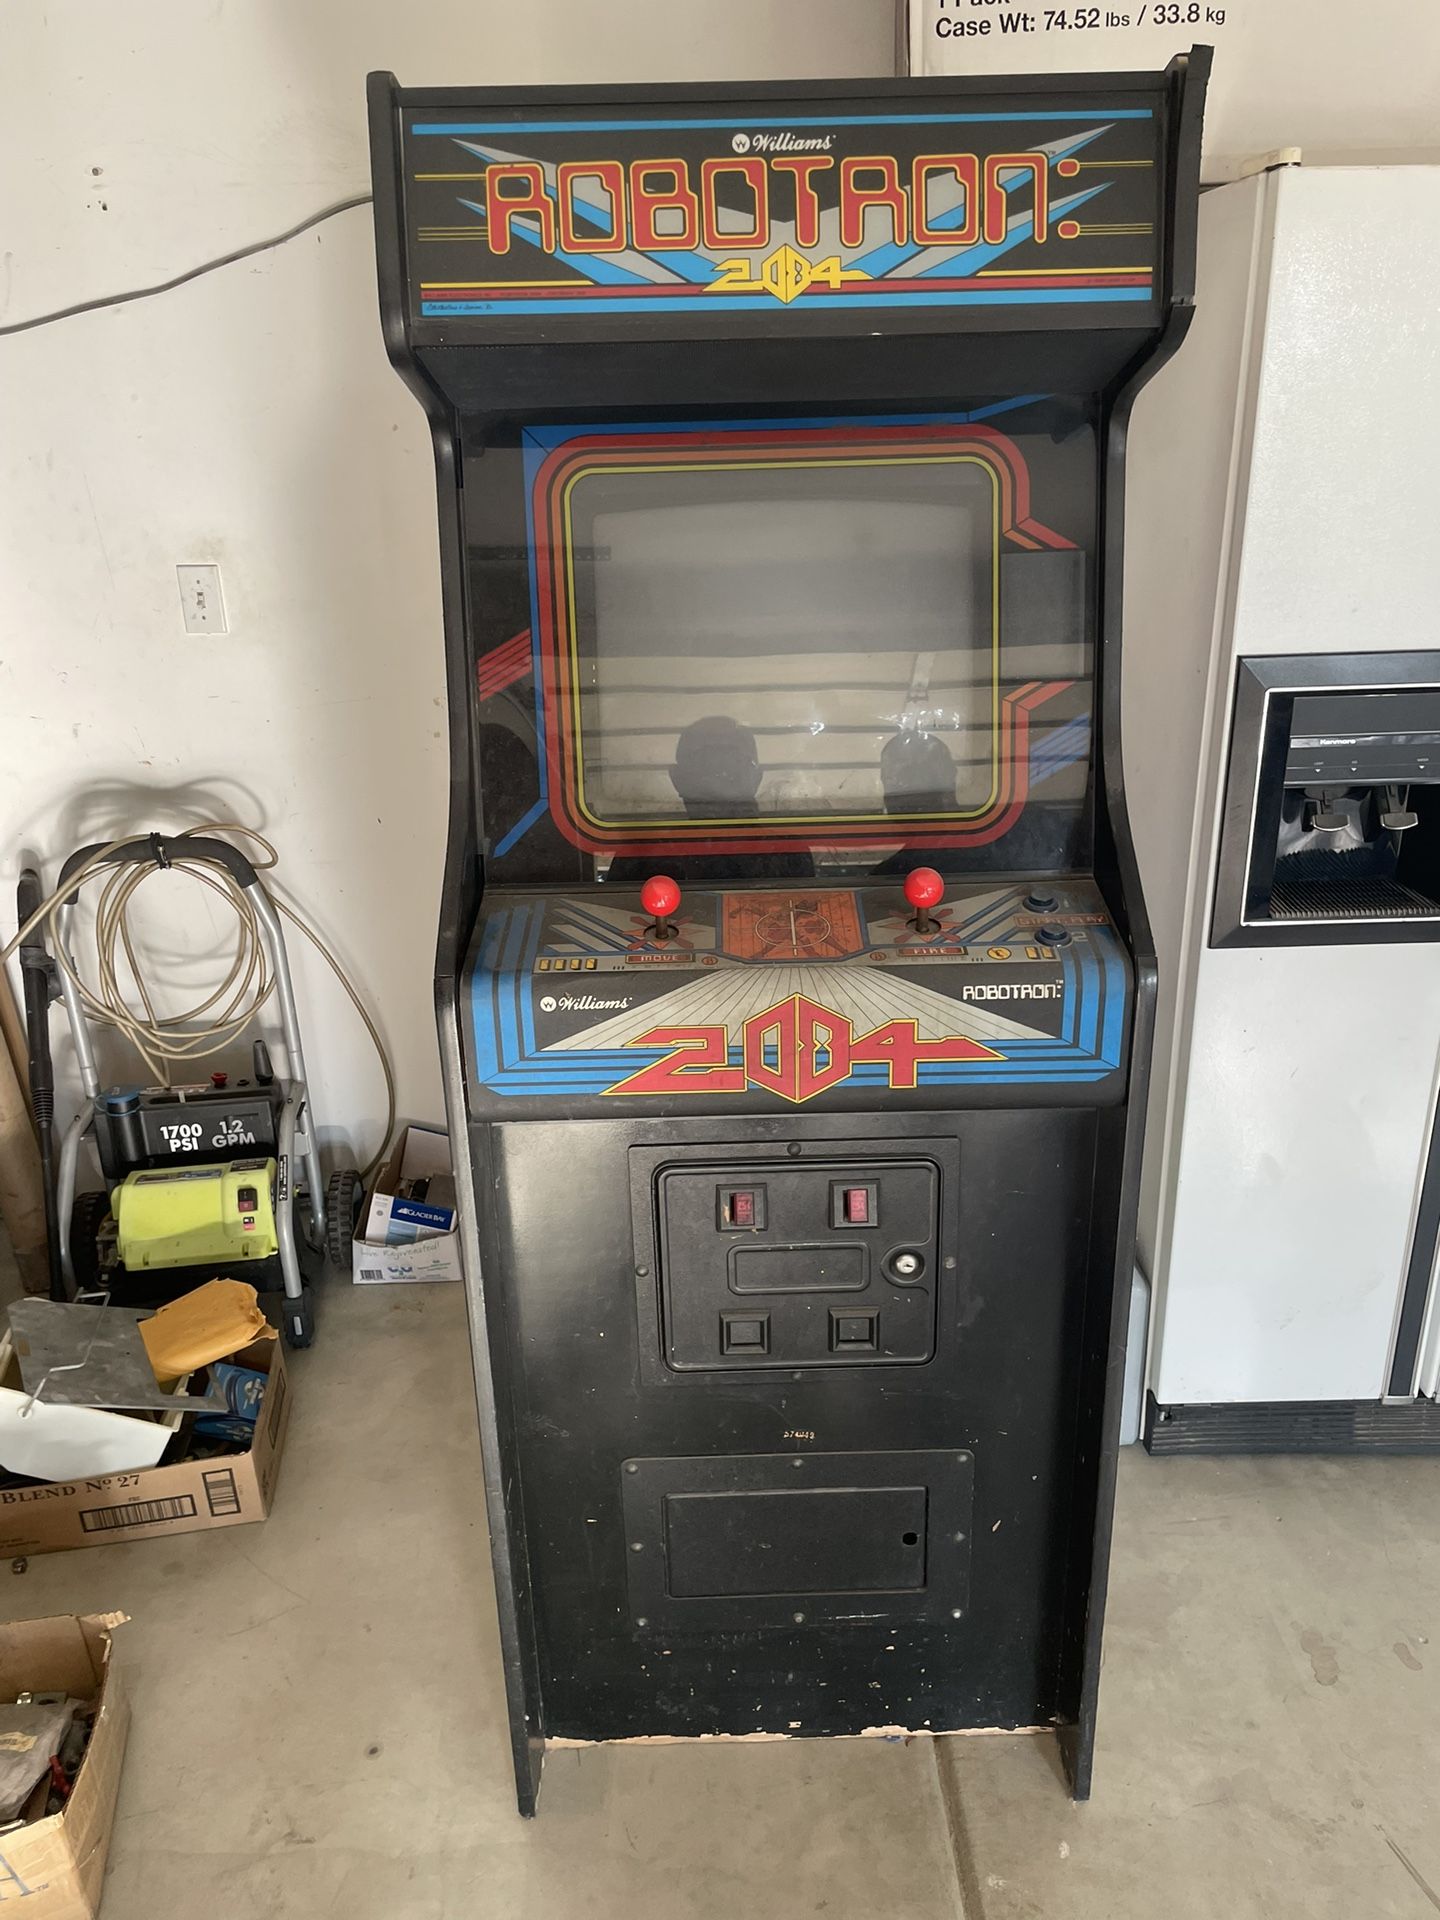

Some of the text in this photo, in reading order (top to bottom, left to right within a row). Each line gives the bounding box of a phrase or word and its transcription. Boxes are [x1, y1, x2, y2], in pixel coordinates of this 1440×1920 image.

[935, 3, 1226, 38] Case Wt: 74.52 lbs / 33.8 kg
[752, 132, 833, 152] Williams
[485, 152, 1081, 255] ROBOTRON:
[702, 244, 875, 304] 2084
[640, 954, 678, 962] MOVE
[962, 984, 1062, 1000] ROBOTRON:
[558, 995, 629, 1011] Williams
[599, 992, 1008, 1104] 2084
[160, 1123, 203, 1140] 1700
[218, 1119, 244, 1135] 1.2
[169, 1137, 199, 1152] PSI
[211, 1132, 256, 1148] GPM
[0, 1486, 76, 1504] BLEND
[118, 1474, 141, 1488] 27
